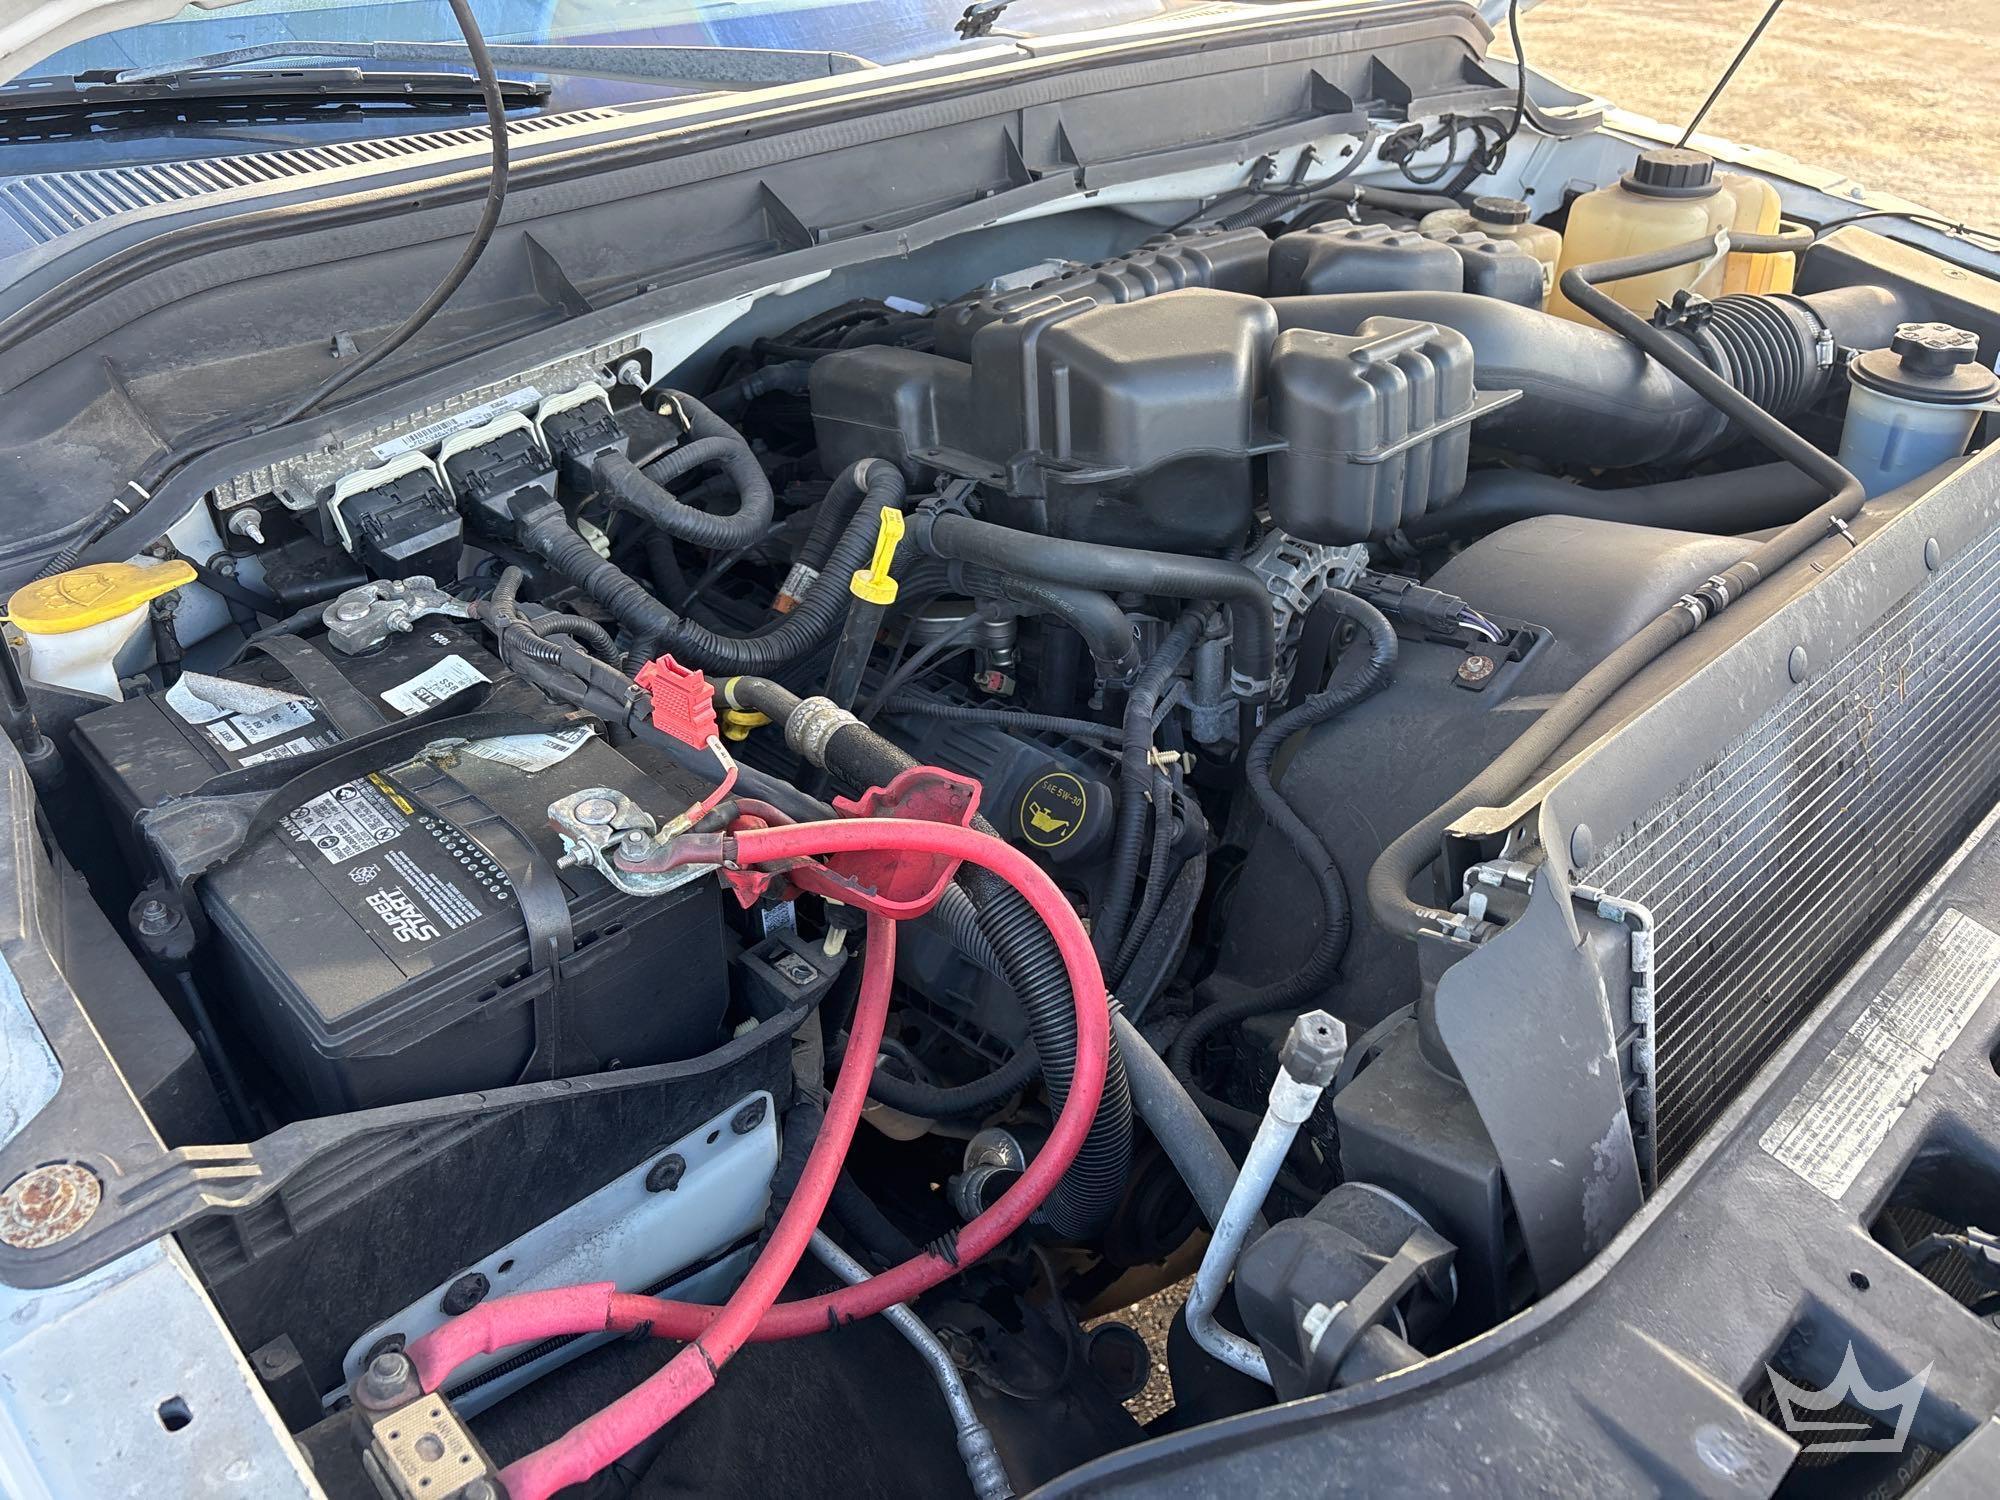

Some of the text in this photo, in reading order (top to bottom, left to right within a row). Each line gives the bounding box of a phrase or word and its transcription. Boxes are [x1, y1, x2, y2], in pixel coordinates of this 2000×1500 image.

[1042, 780, 1082, 807] SAE 5W-30
[365, 893, 418, 943] SUPER
[379, 890, 441, 941] START
